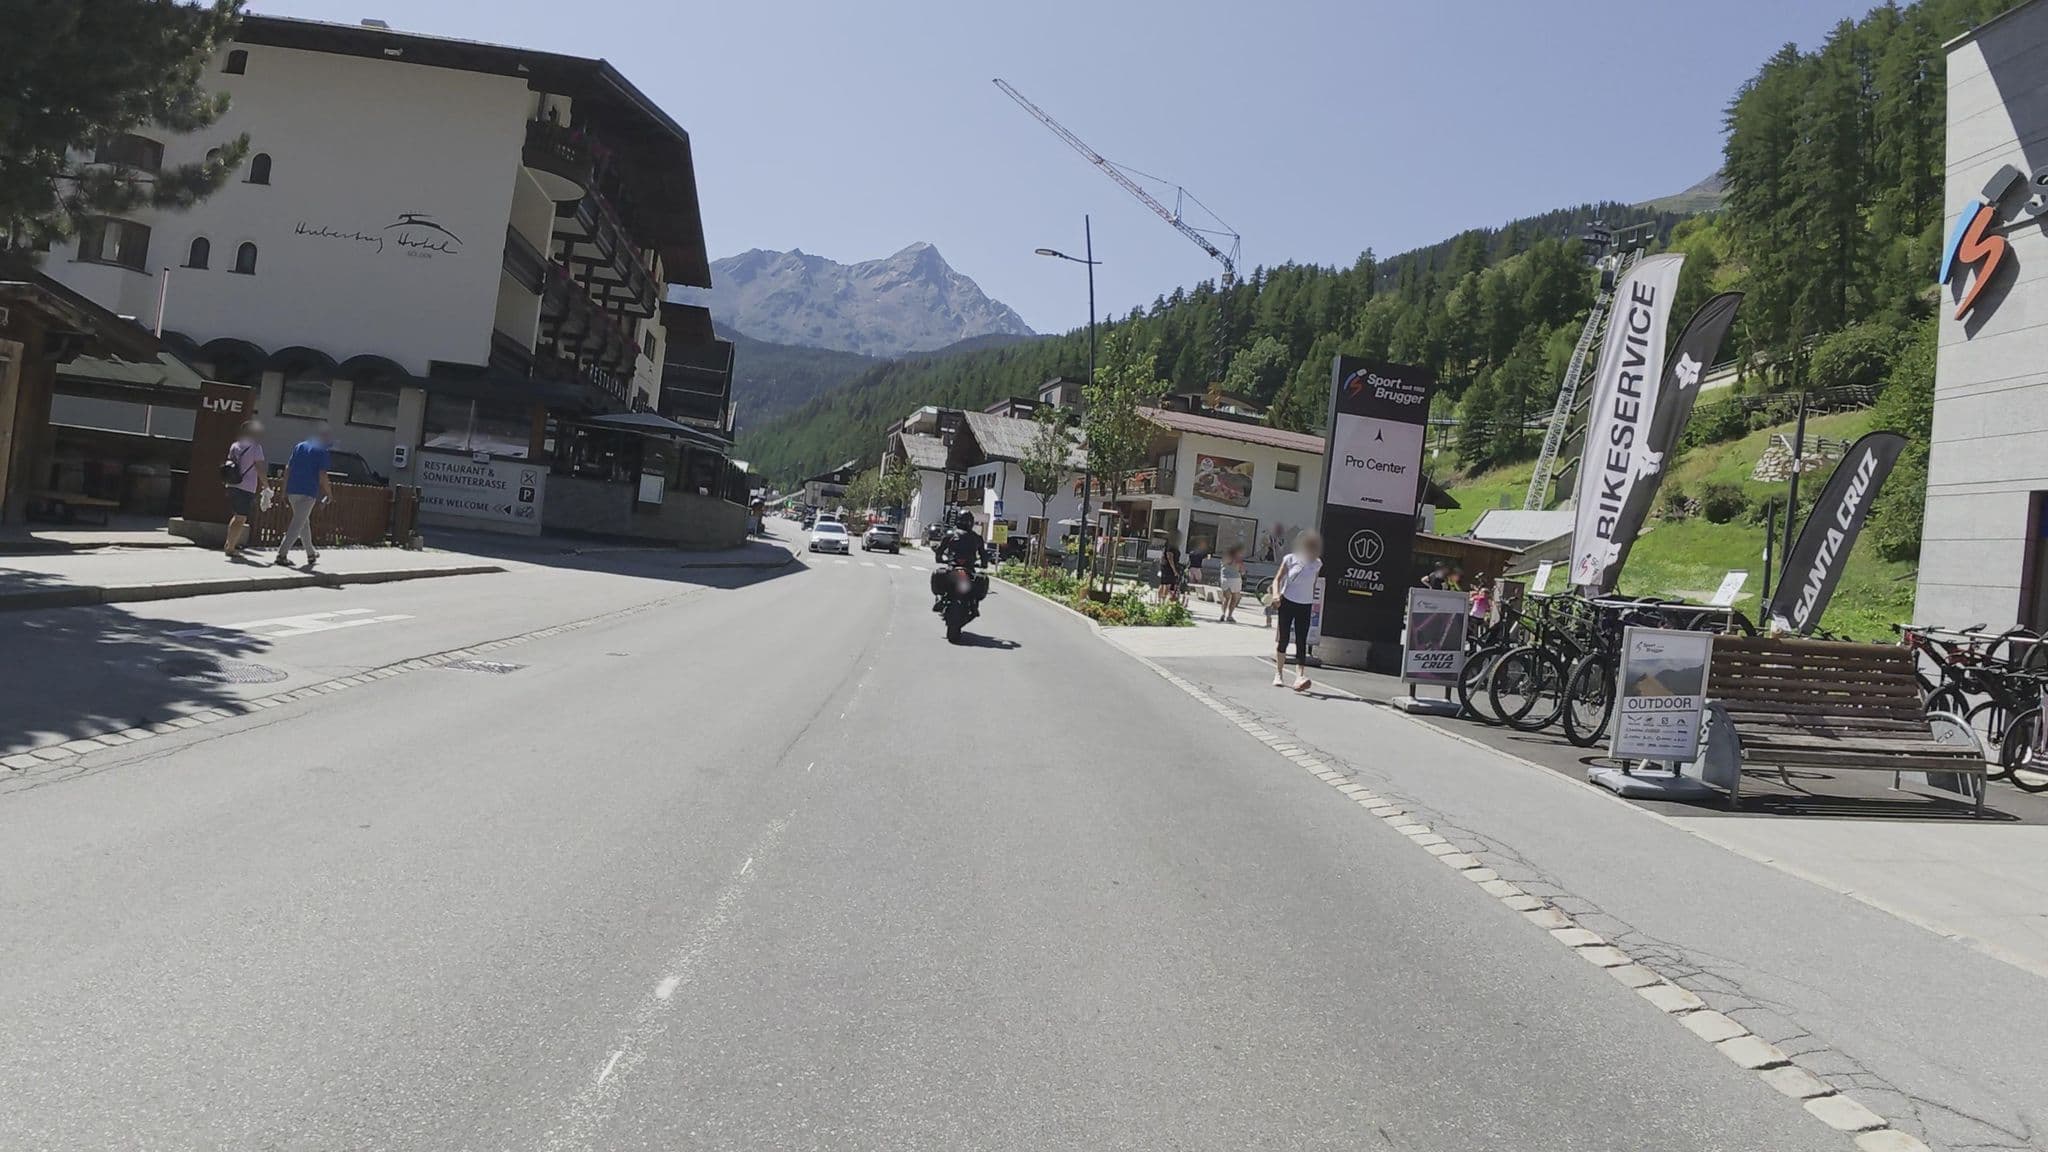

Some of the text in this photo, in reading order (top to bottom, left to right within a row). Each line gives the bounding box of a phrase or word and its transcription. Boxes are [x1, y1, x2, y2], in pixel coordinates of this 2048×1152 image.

[397, 231, 458, 254] Hotel
[1367, 373, 1402, 390] Sport
[202, 396, 243, 413] LIVE
[1375, 387, 1425, 405] Brugger
[1596, 280, 1656, 540] BIKESERVICE
[424, 460, 495, 477] RESTAURANT &
[1345, 455, 1406, 474] Pro Center
[422, 471, 507, 490] SONNENTERRASSE
[446, 499, 489, 512] WELCOME
[1793, 447, 1878, 628] SANTA CRUZ
[1344, 567, 1381, 581] SIDAS
[1413, 653, 1454, 661] SANTA
[1628, 698, 1692, 709] OUTDOOR
